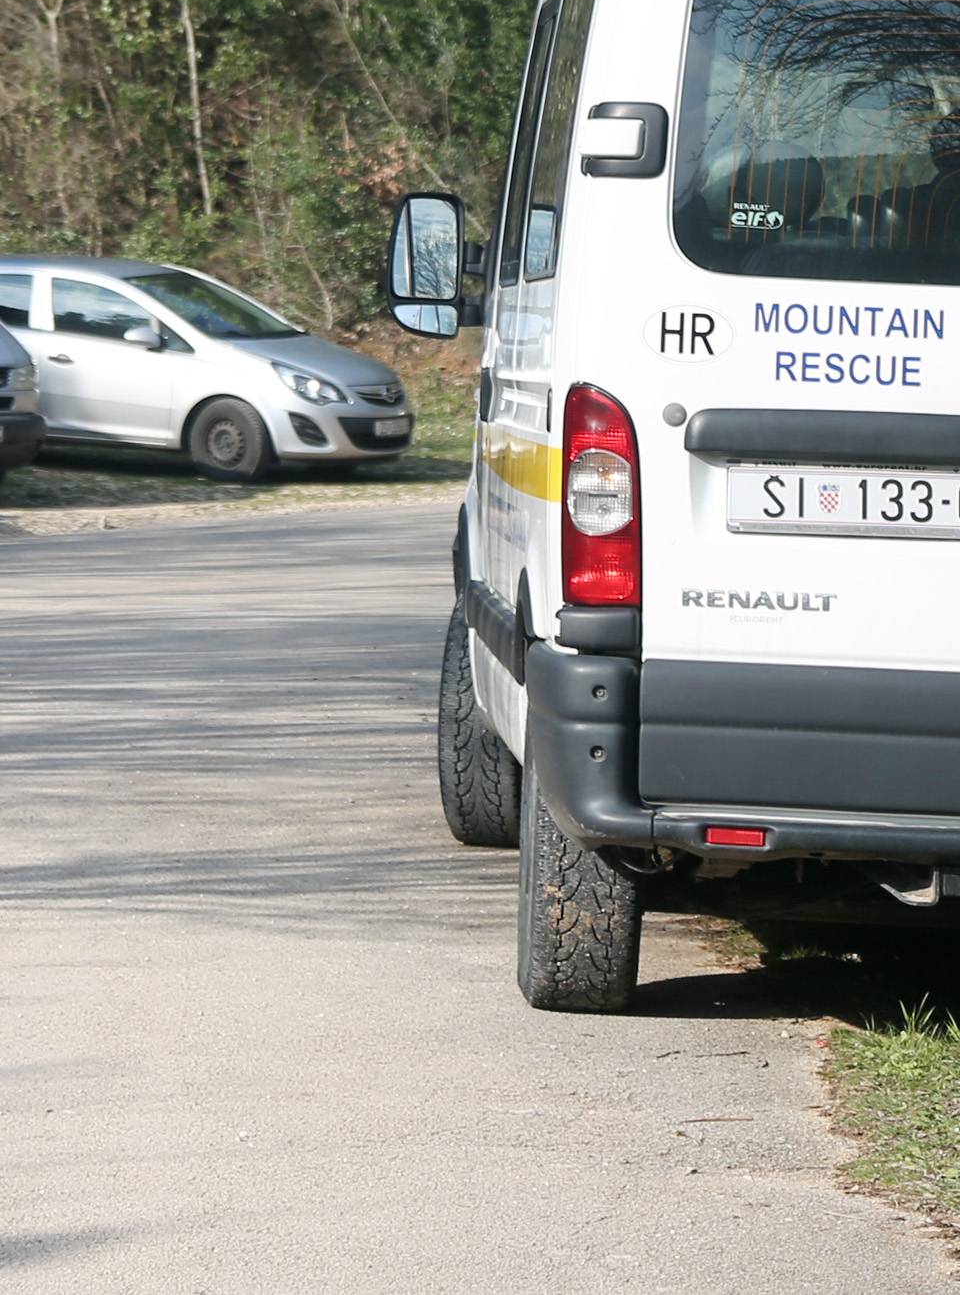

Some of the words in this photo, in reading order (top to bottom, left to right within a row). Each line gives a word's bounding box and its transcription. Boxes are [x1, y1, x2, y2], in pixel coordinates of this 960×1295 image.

[660, 311, 716, 356] HR
[754, 302, 945, 340] MOUNTAIN
[775, 351, 922, 387] RESCUE
[763, 474, 804, 518] ŠI
[681, 587, 838, 613] RENAULT
